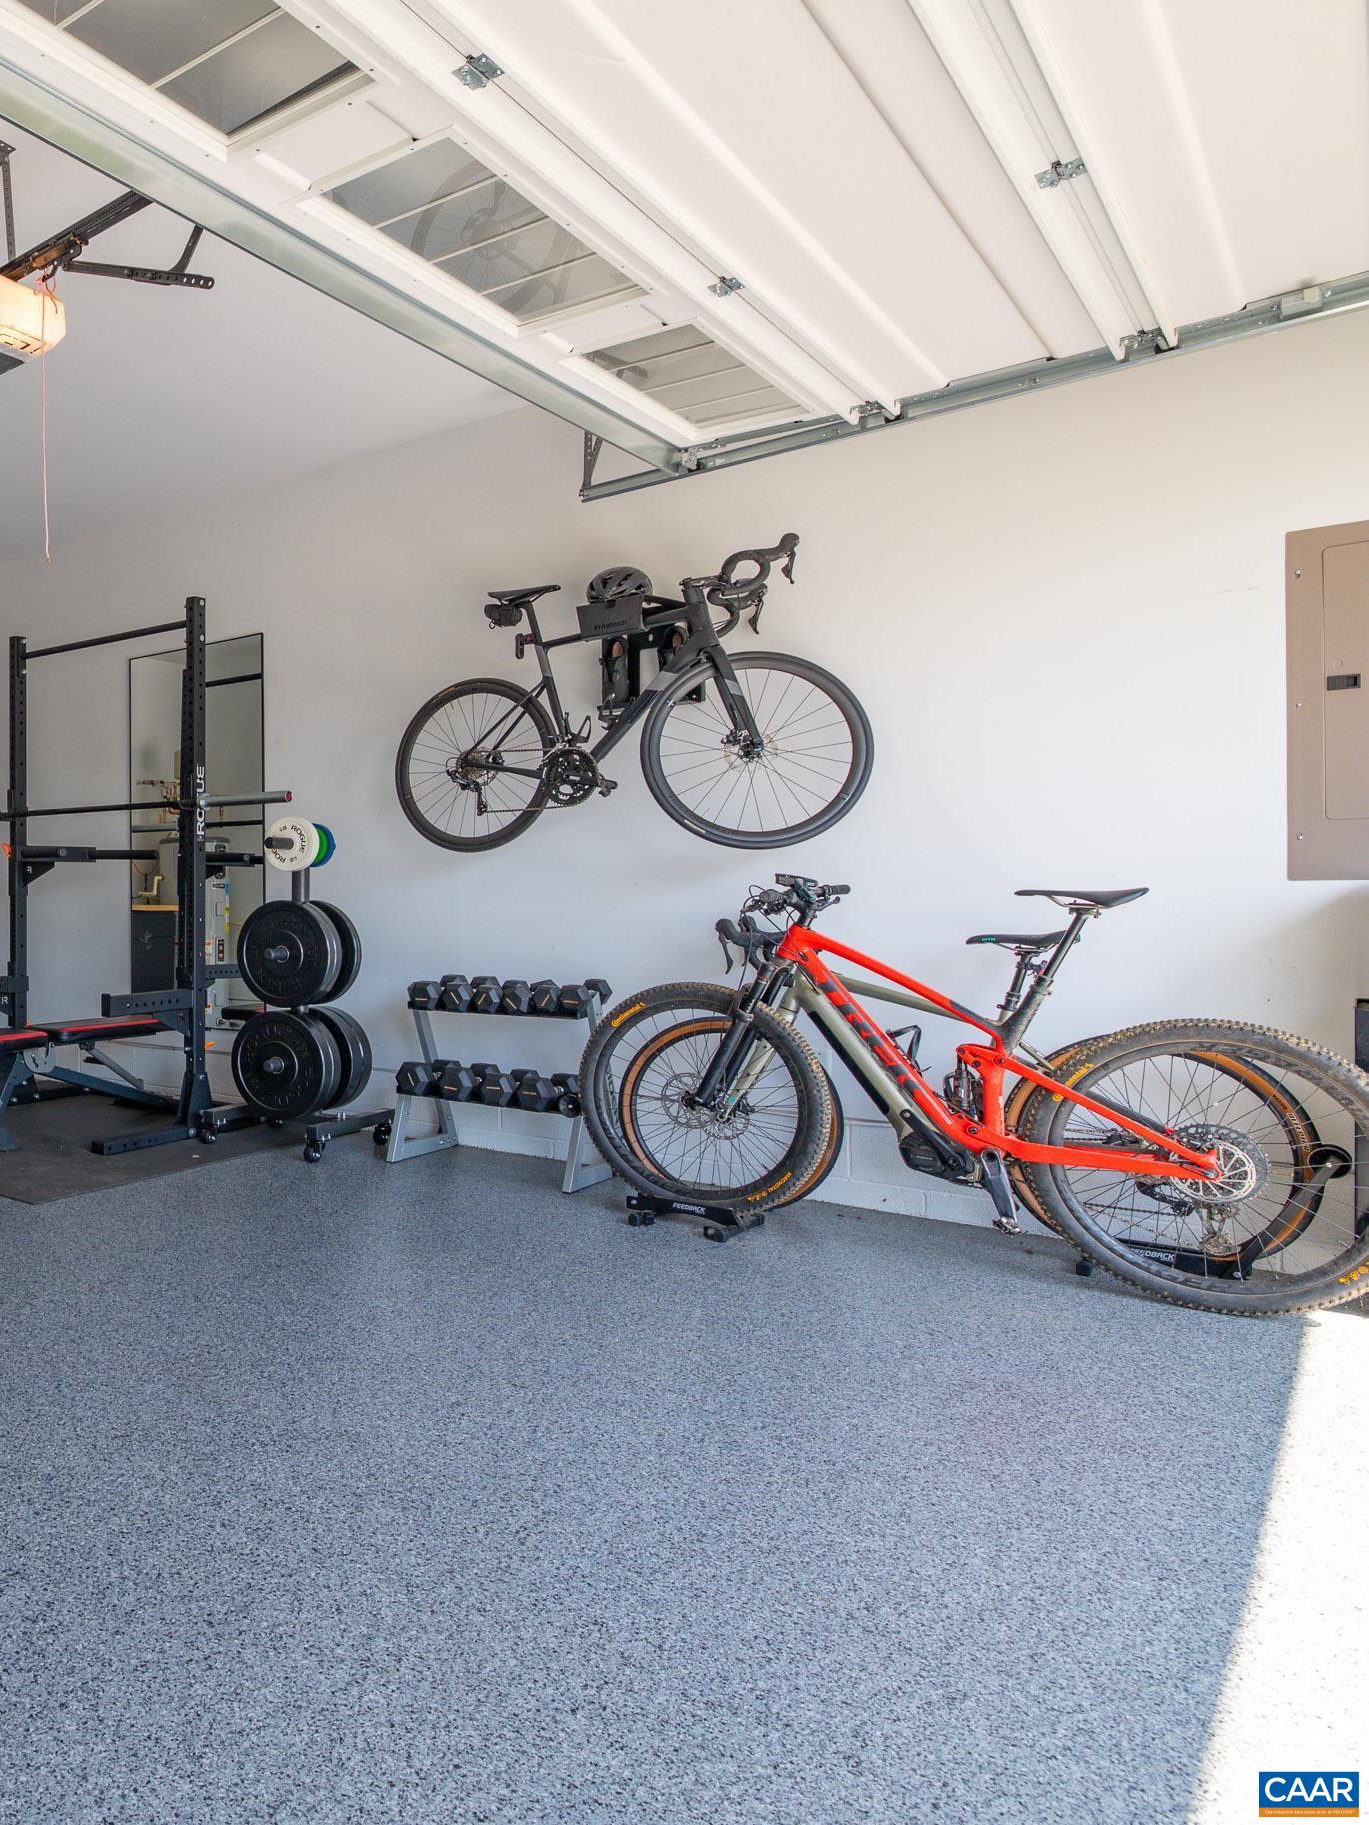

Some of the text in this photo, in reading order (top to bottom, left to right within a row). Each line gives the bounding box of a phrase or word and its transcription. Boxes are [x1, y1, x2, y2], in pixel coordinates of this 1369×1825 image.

[197, 764, 205, 835] ROUE
[291, 825, 306, 854] ROGUE
[672, 1202, 706, 1214] FEEDBACK
